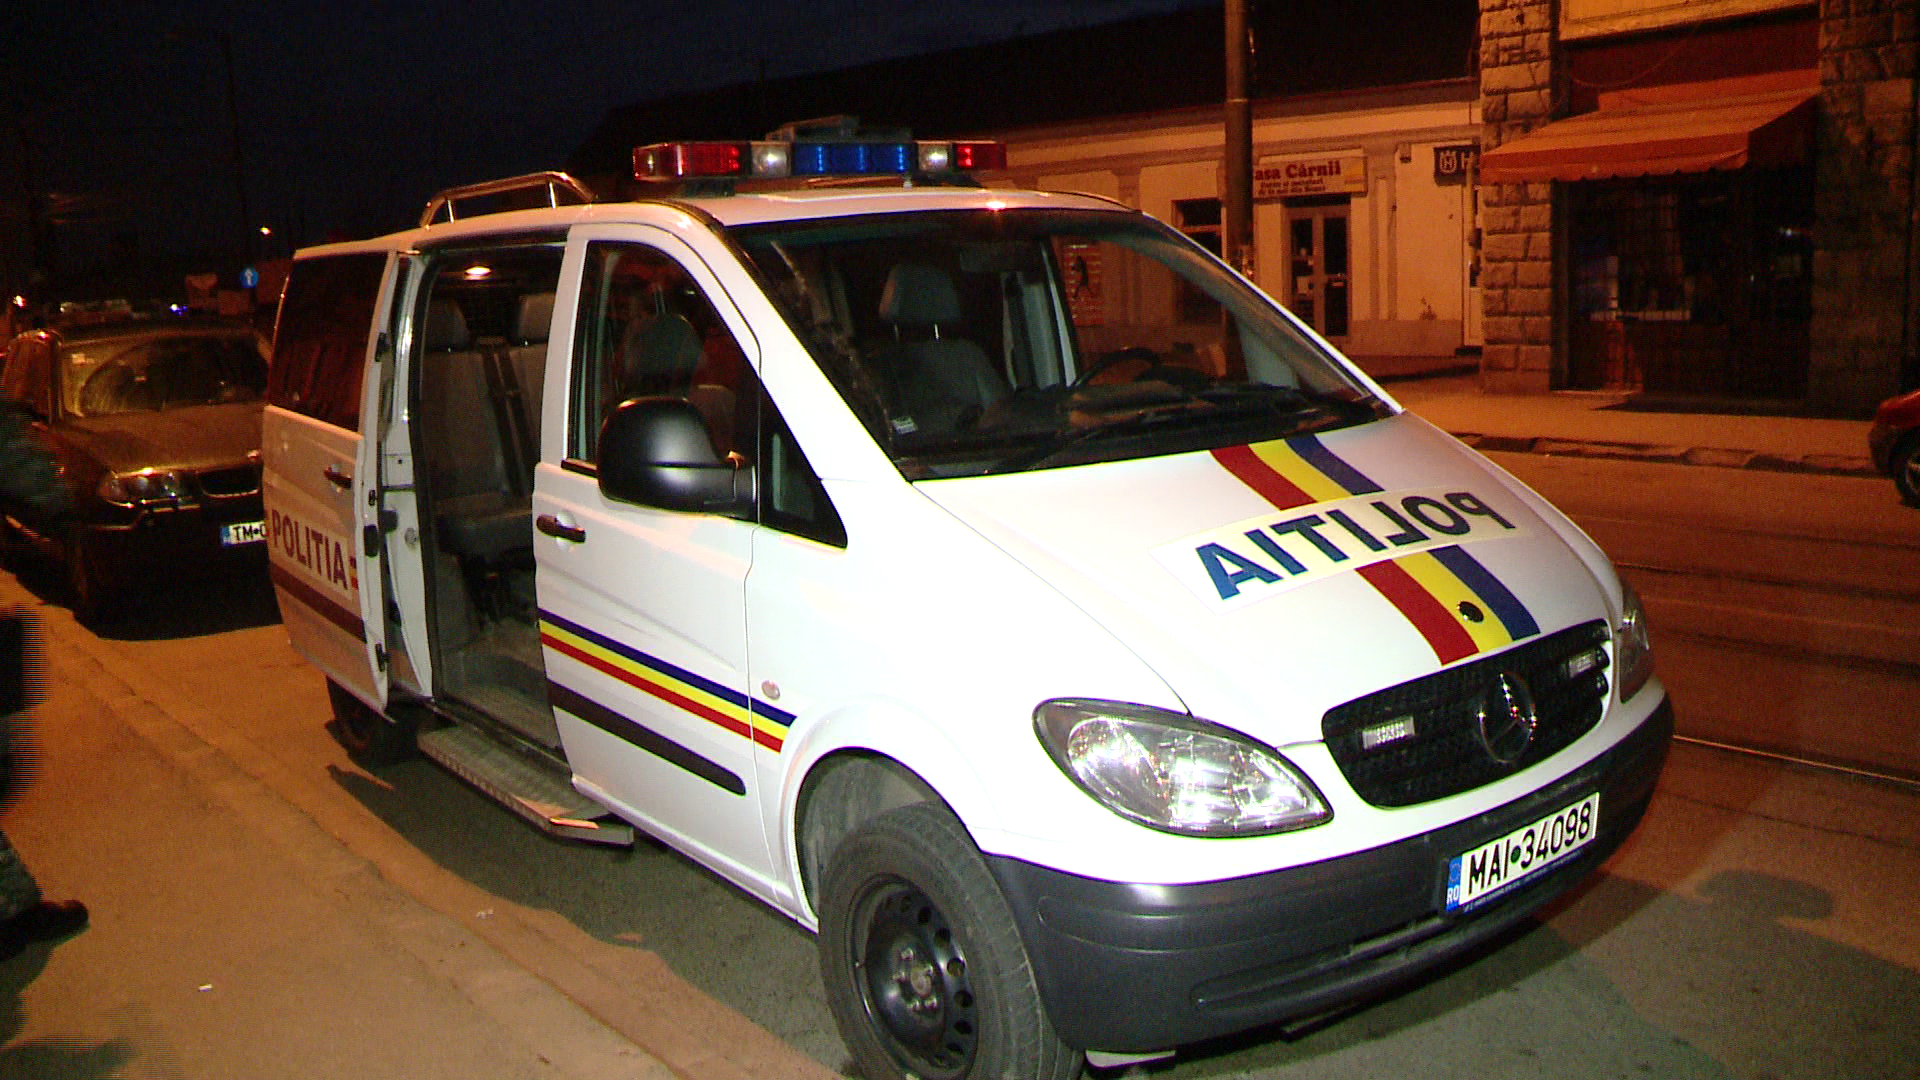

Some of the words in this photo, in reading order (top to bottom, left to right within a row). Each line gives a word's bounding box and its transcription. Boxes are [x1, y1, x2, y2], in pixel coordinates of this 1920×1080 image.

[1255, 168, 1281, 180] asa
[272, 509, 348, 590] POLITIA
[1447, 884, 1460, 906] RO
